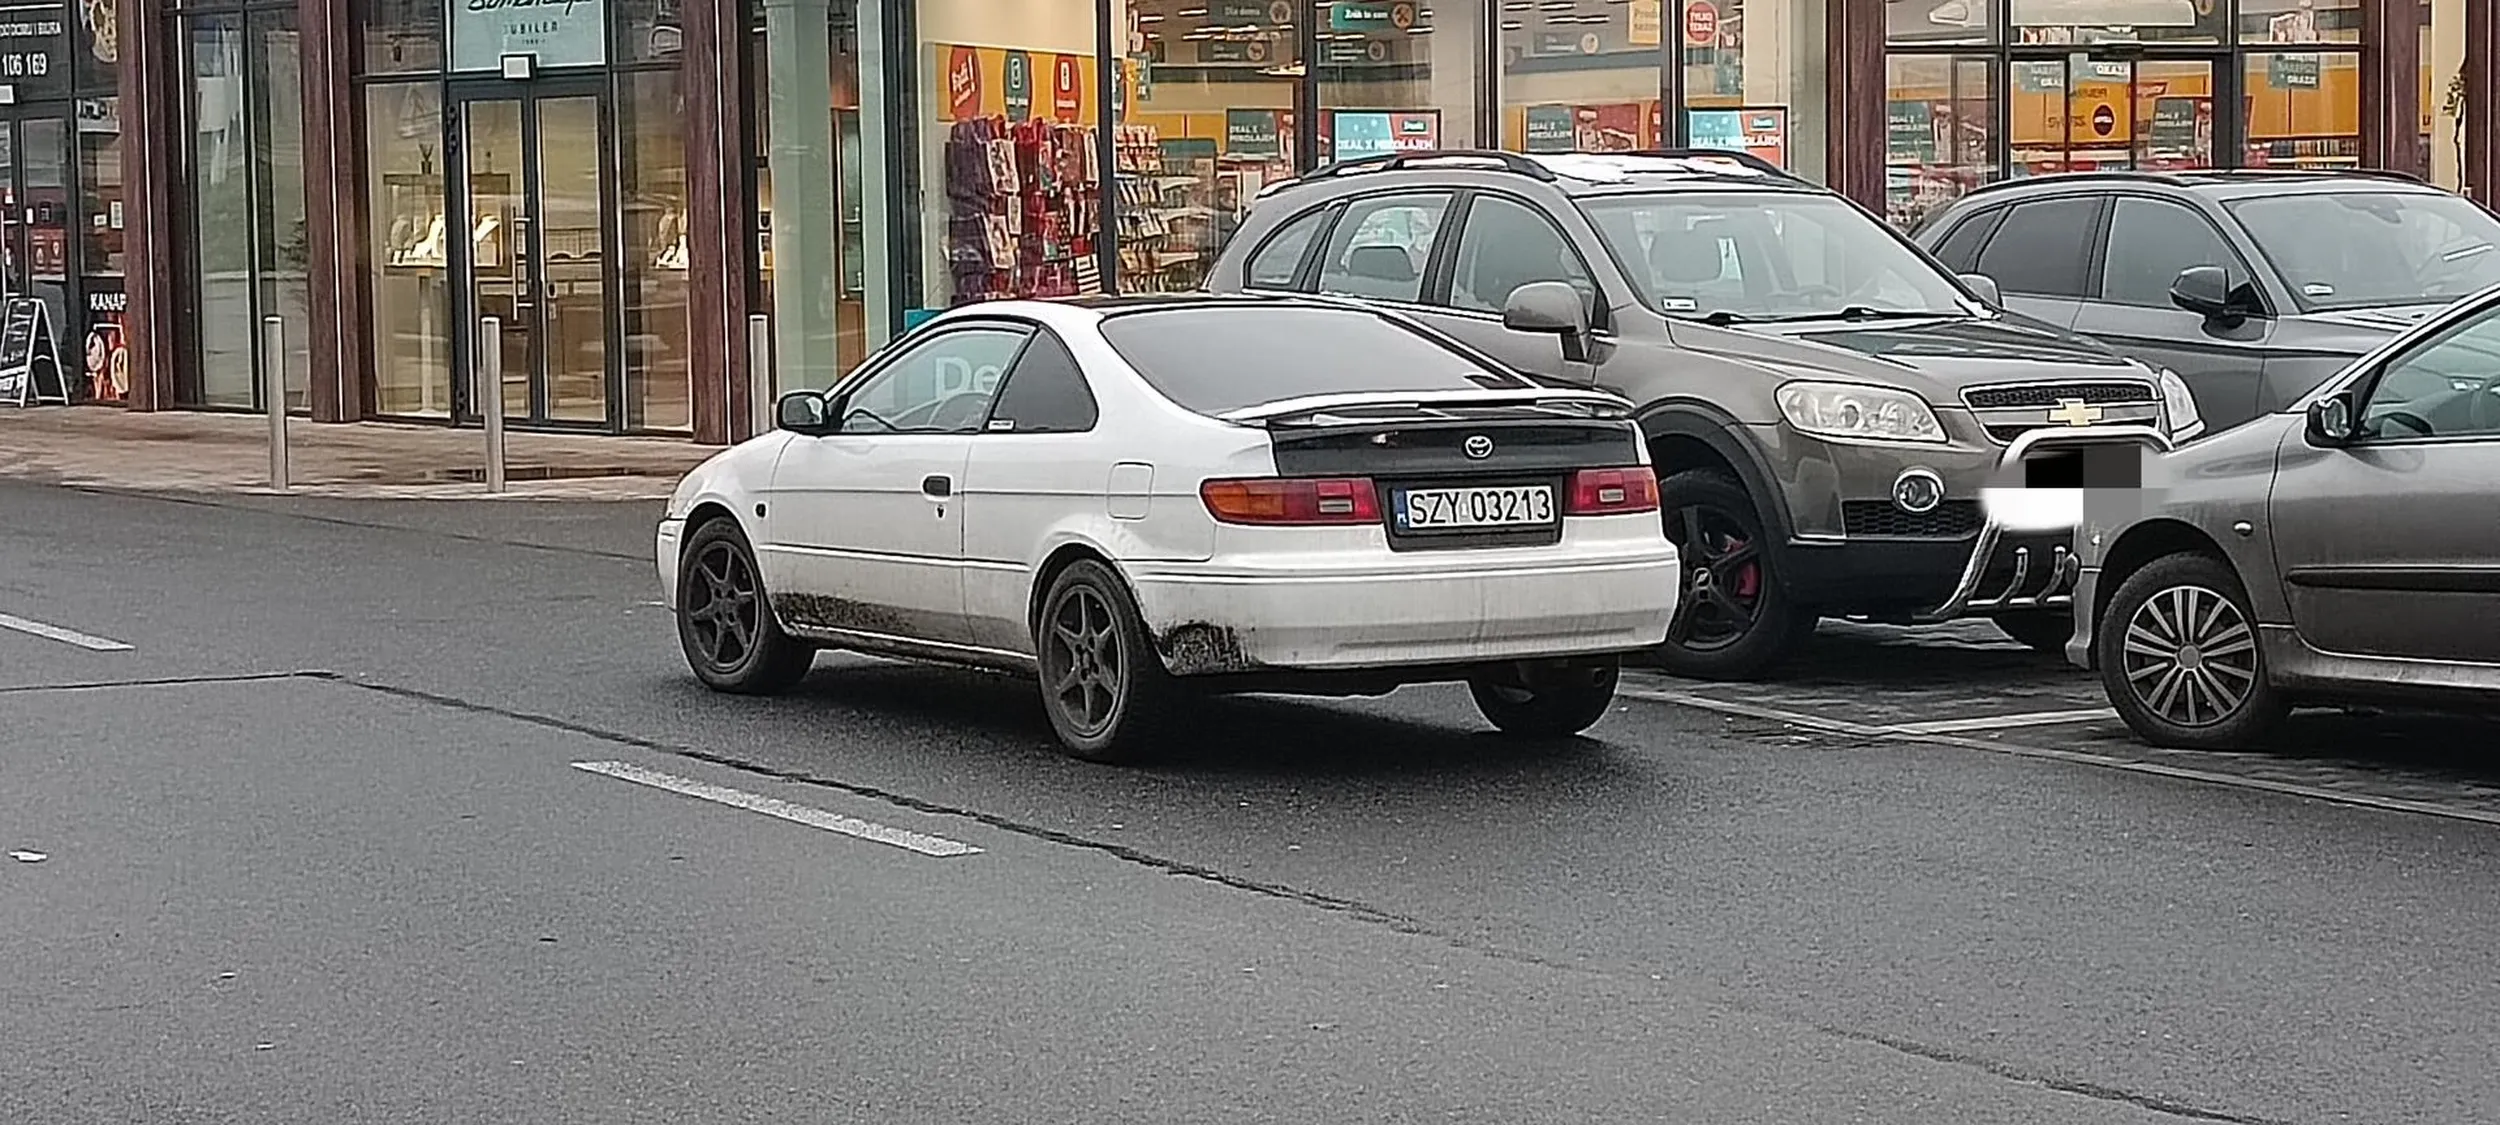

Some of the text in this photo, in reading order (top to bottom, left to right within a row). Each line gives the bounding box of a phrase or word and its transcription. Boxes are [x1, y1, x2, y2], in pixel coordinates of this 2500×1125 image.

[1690, 11, 1713, 21] TYLKO
[1690, 22, 1713, 32] TERAZ
[2, 53, 47, 76] 106 169
[1409, 491, 1461, 525] SZY
[1470, 488, 1551, 522] 03213
